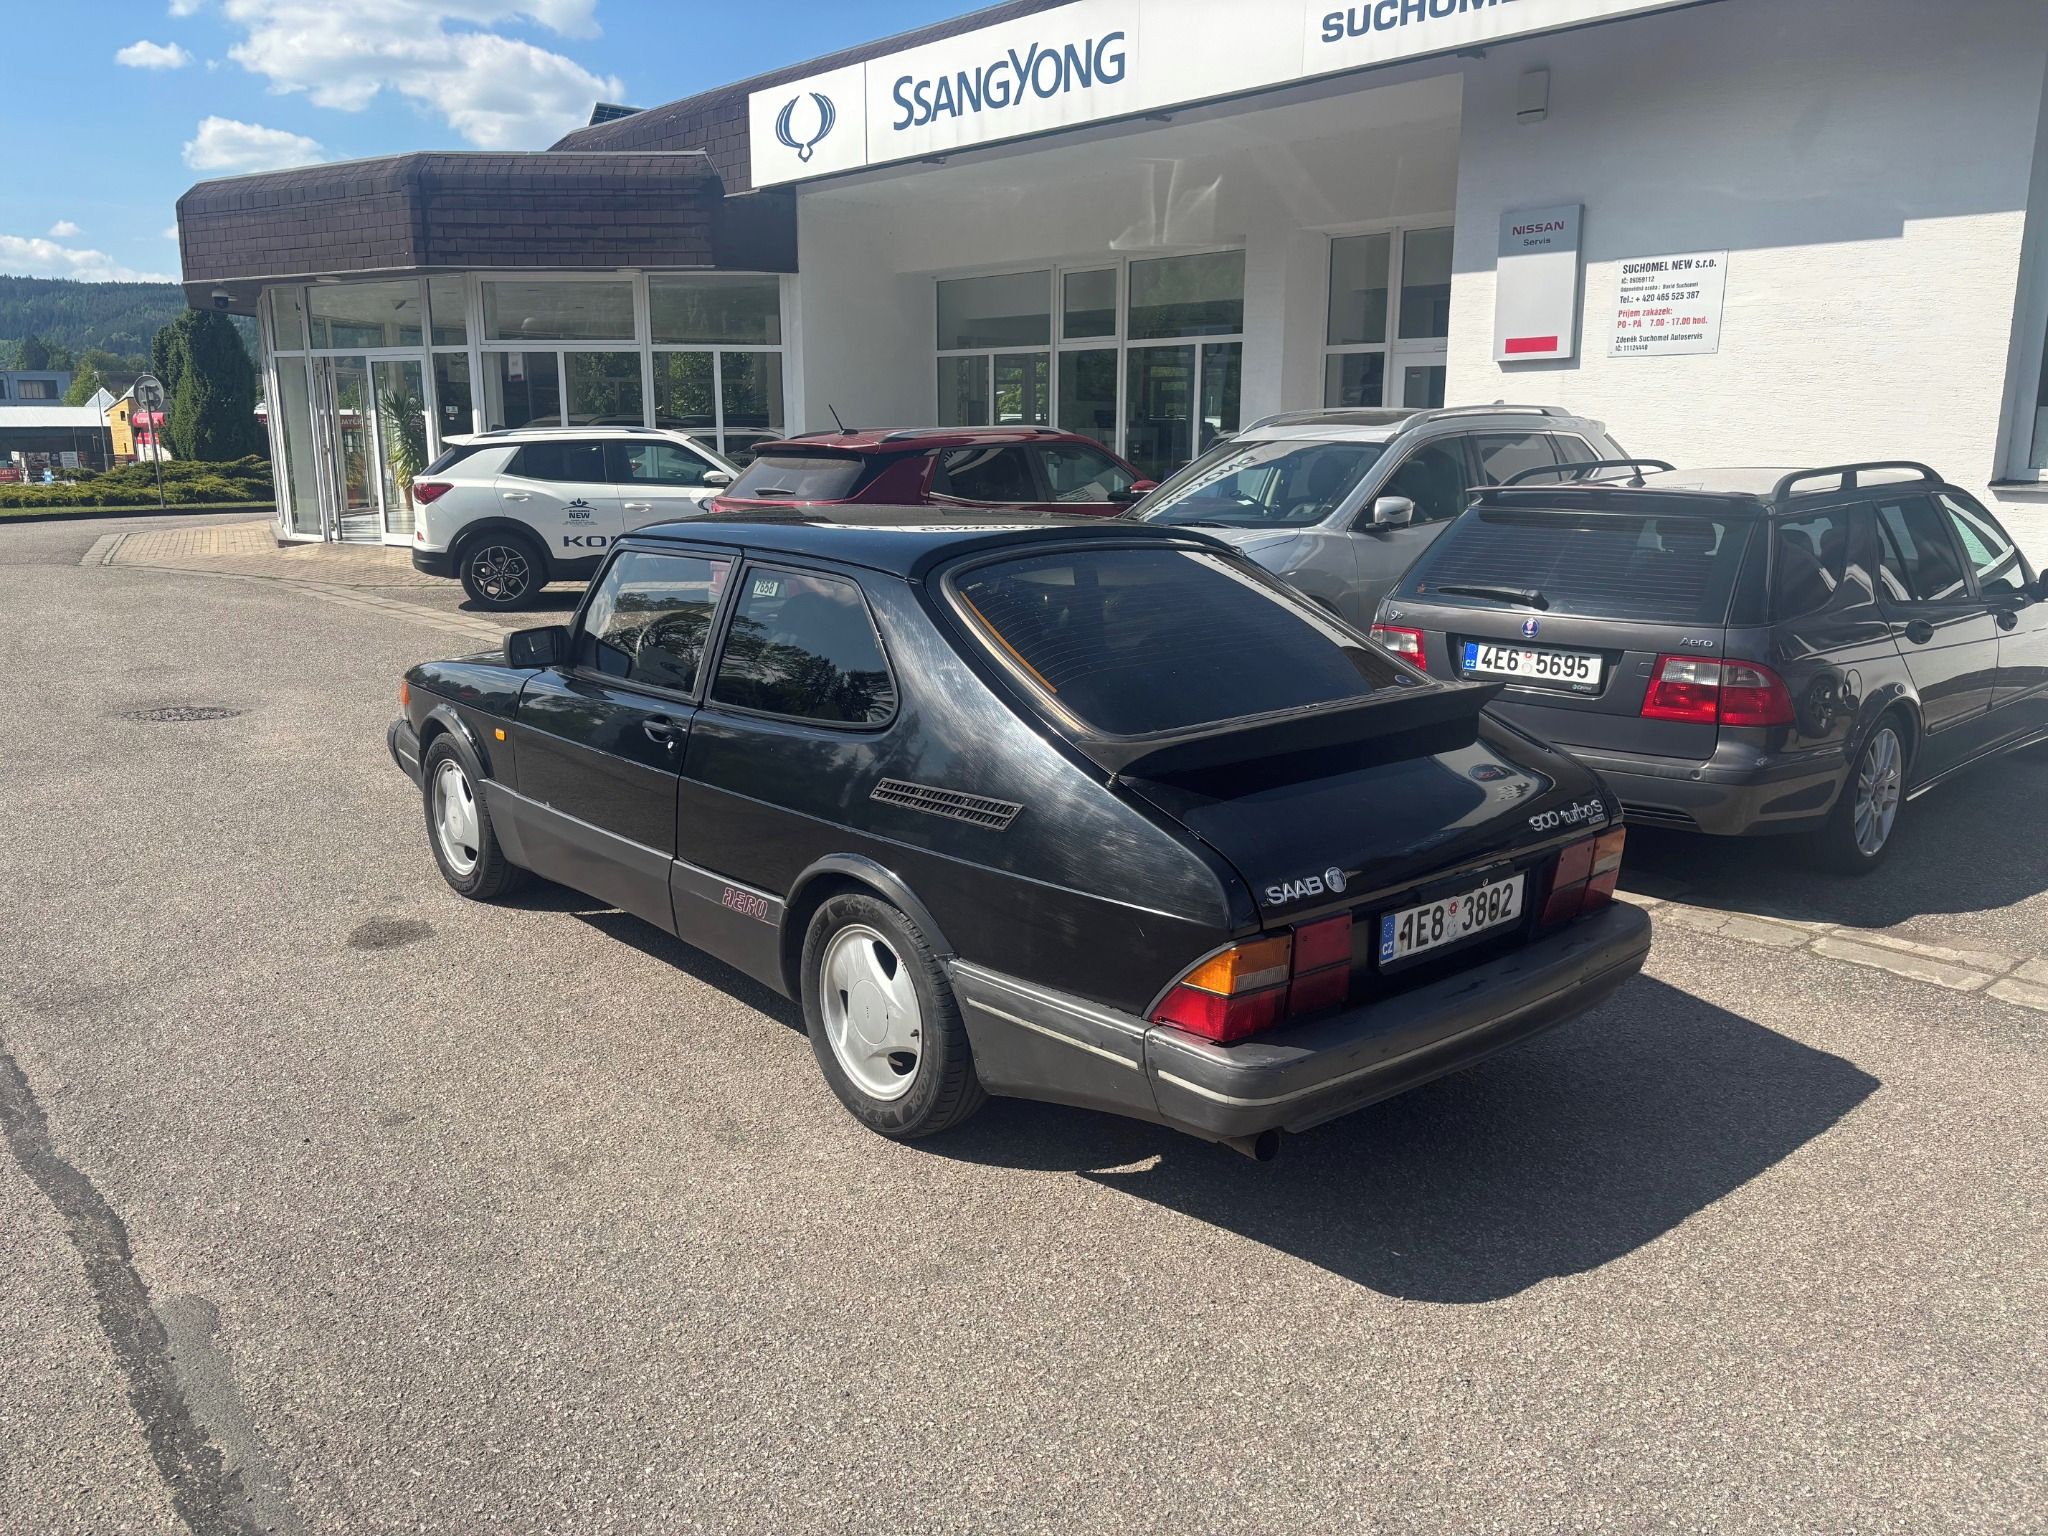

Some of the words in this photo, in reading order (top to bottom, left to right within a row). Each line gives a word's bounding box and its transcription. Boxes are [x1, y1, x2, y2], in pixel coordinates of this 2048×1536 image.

[1321, 0, 1521, 43] SUCHO
[893, 31, 1126, 131] SSANGYONG
[1512, 220, 1565, 236] NISSAN
[1523, 236, 1551, 247] Servis
[1622, 261, 1669, 274] SUCHOMEL
[1672, 259, 1693, 271] NEW
[1695, 259, 1717, 269] s.r.o.
[1642, 294, 1655, 302] 420
[1657, 292, 1670, 301] 465
[1671, 291, 1685, 300] 525
[1617, 320, 1627, 329] PO
[1650, 318, 1665, 327] 7.00
[1672, 317, 1690, 326] 17.00
[1692, 315, 1708, 324] hod.
[1639, 334, 1669, 343] Suchomel
[1670, 332, 1703, 341] Autoservis
[563, 535, 616, 547] KO
[1680, 637, 1713, 647] Aero
[1465, 659, 1475, 667] CZ
[1481, 646, 1520, 671] 4E6
[1535, 651, 1591, 679] 5695
[1529, 810, 1560, 831] 900
[1265, 876, 1324, 905] SAAB
[722, 886, 768, 919] AERO
[1382, 941, 1393, 955] CZ
[1400, 905, 1444, 950] 1E8
